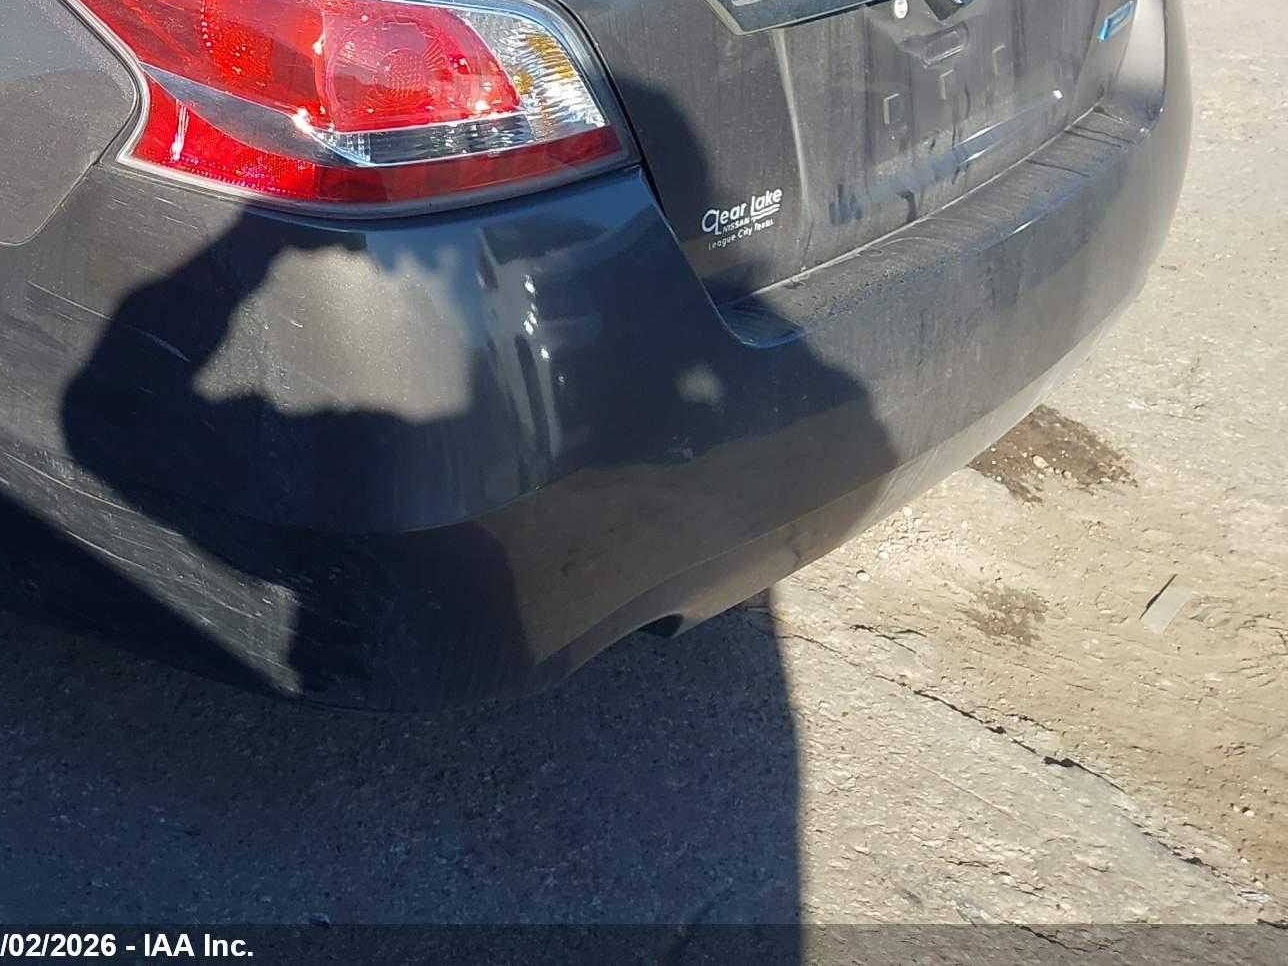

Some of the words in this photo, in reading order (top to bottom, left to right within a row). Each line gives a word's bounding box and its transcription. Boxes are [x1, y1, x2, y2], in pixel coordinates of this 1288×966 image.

[702, 203, 747, 235] Clear
[751, 189, 782, 216] Lake
[723, 217, 750, 233] NISSAN
[709, 234, 737, 250] League
[738, 227, 753, 238] City
